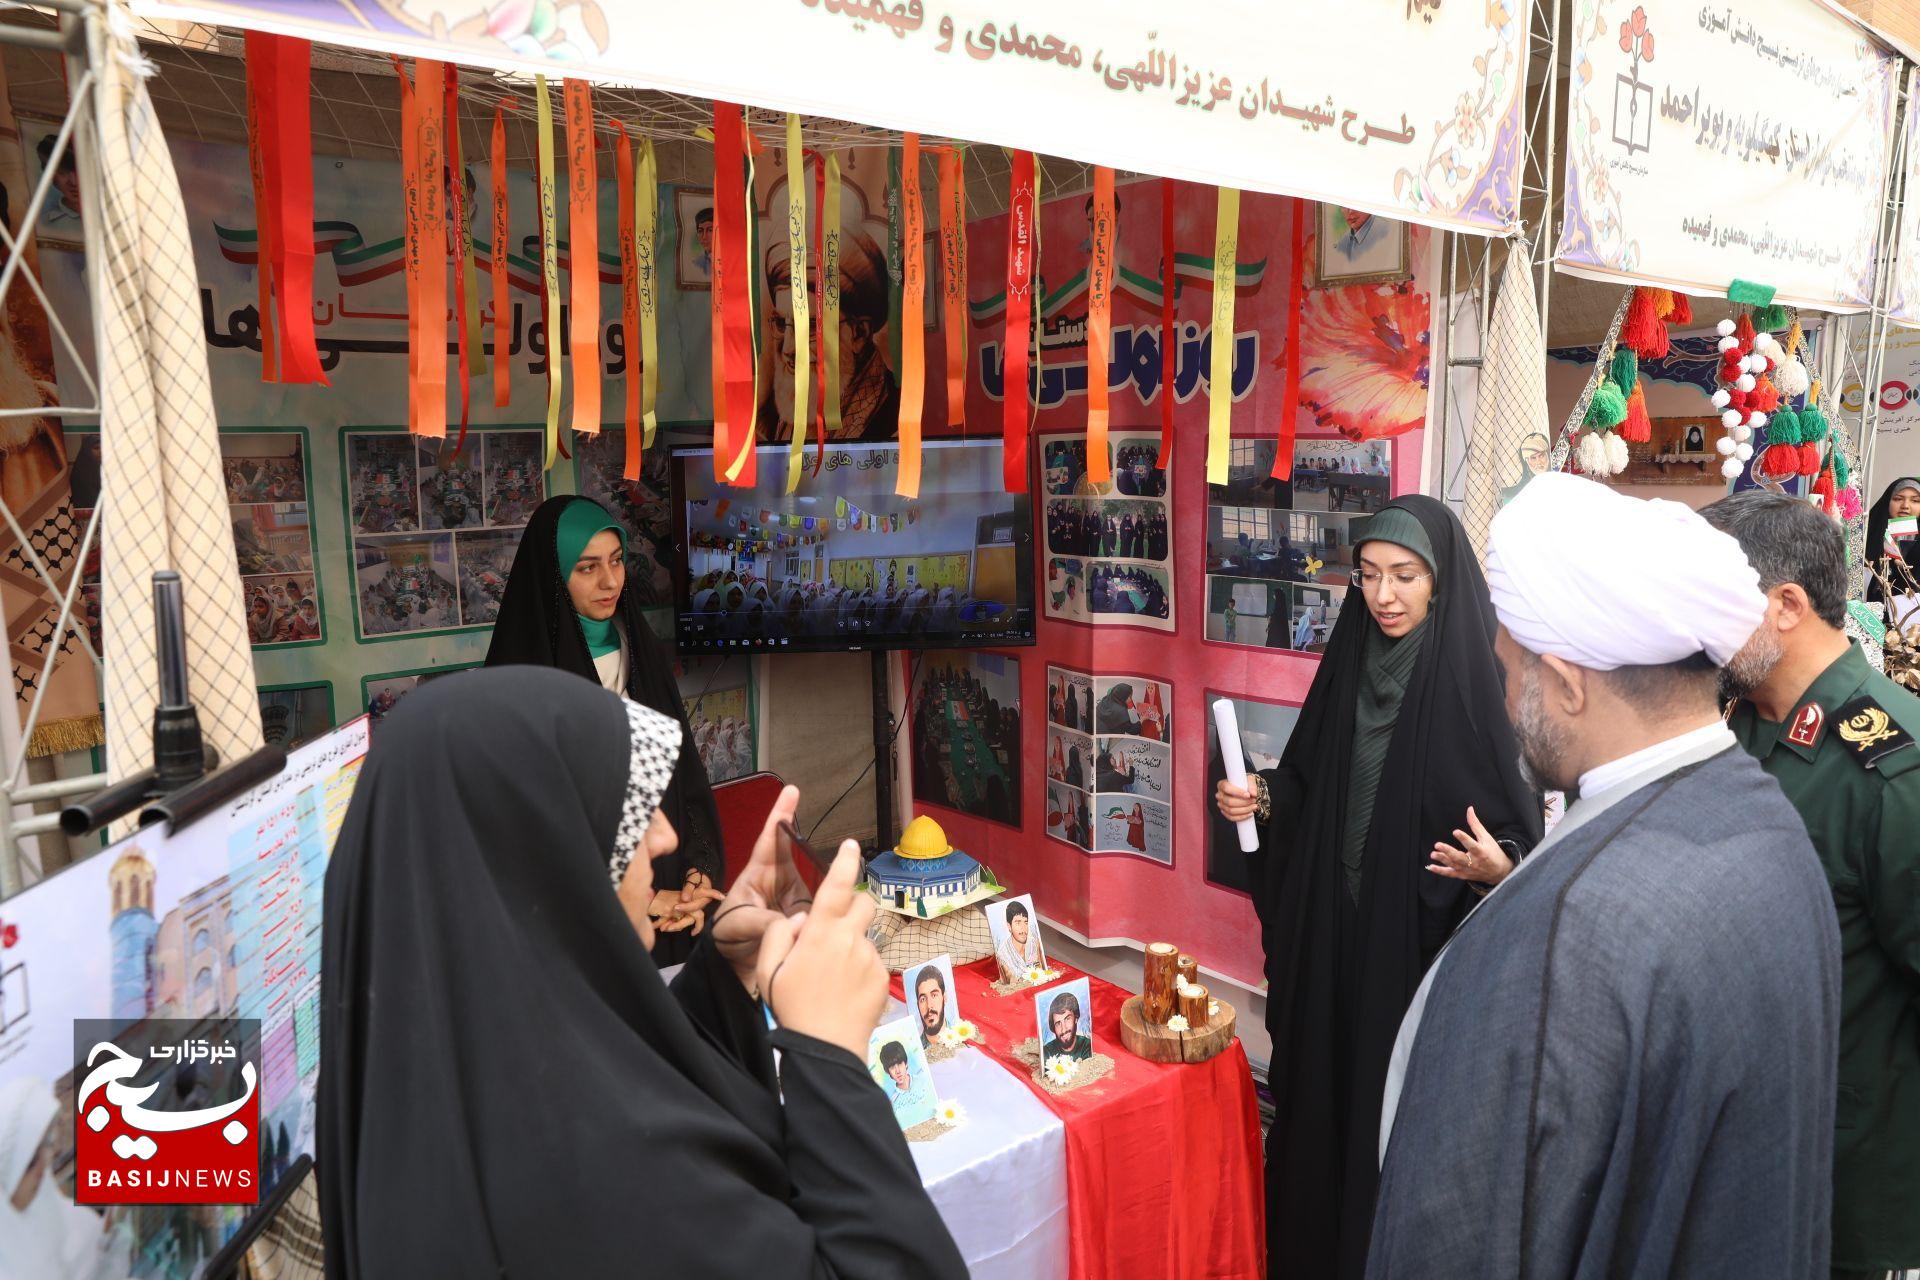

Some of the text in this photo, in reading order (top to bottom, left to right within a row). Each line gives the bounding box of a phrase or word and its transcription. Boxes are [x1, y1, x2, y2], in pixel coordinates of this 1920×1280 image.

[934, 15, 954, 53] و
[965, 22, 1082, 69] محمدی
[1239, 77, 1336, 132] شهیدان
[1341, 109, 1416, 146] طرح
[1014, 205, 1028, 276] شهید القدس
